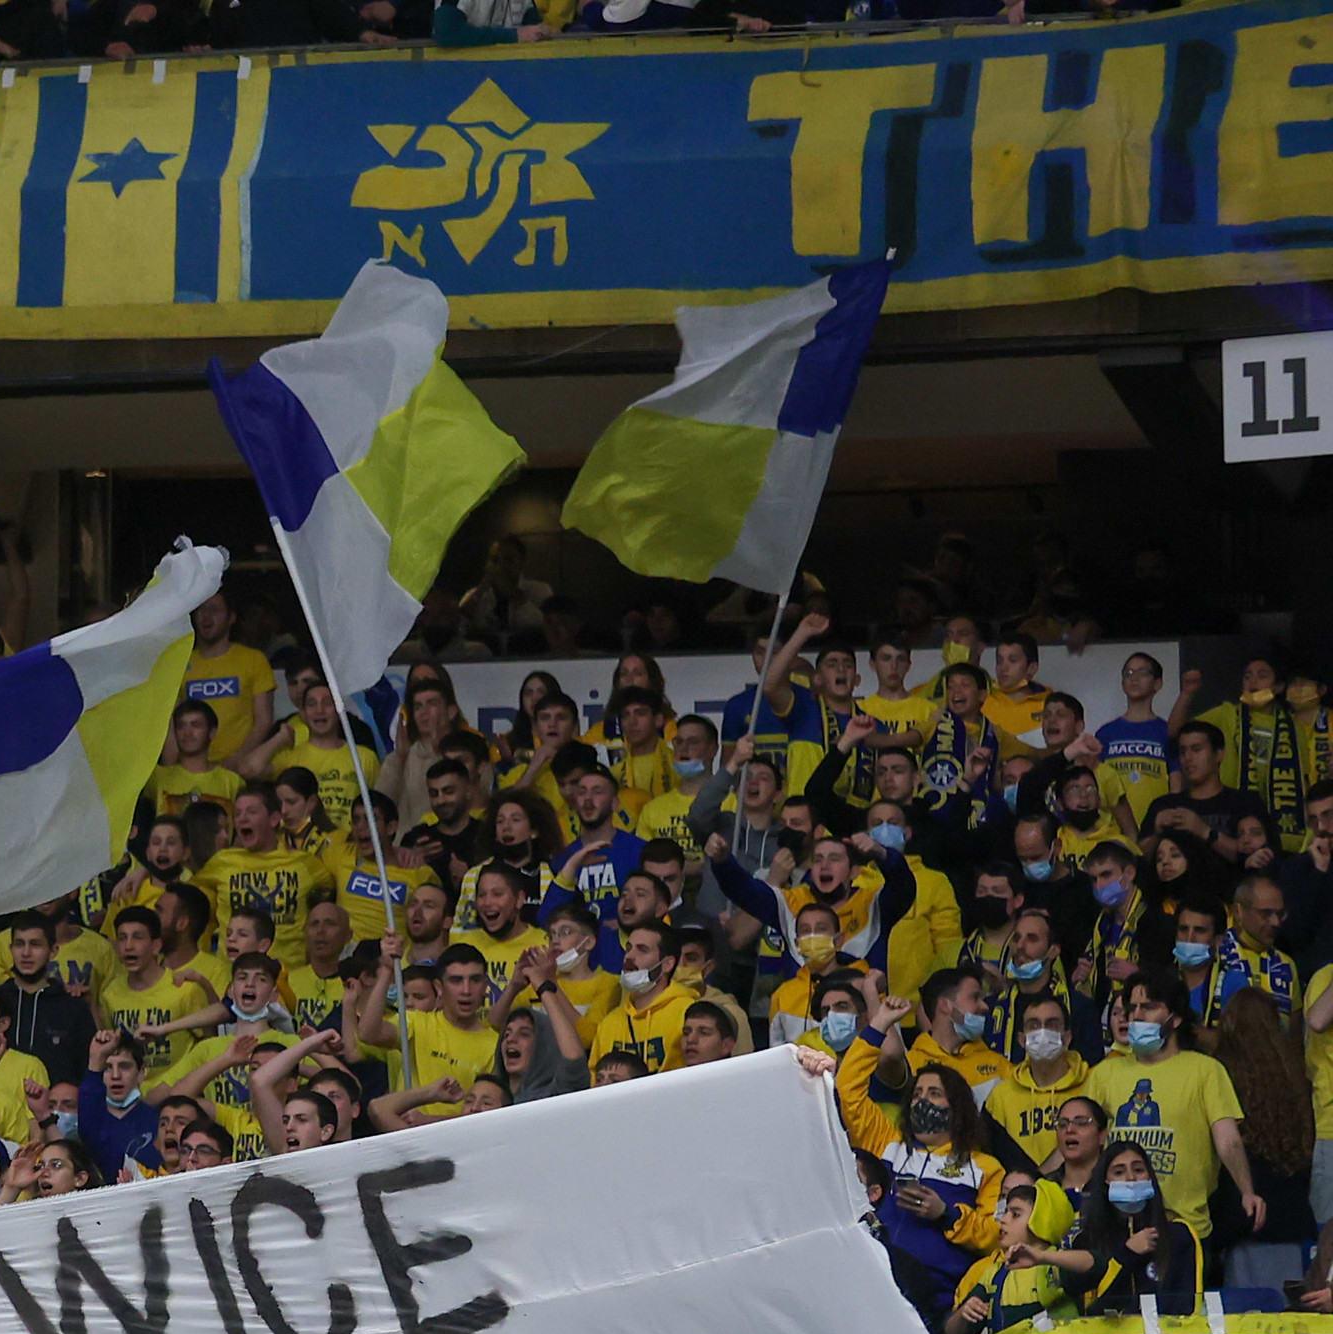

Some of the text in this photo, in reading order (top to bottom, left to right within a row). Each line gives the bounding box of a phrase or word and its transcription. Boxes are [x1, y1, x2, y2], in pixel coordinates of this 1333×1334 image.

[747, 15, 1333, 256] THE
[1240, 356, 1321, 438] 11
[188, 679, 235, 697] FOX
[229, 871, 299, 890] NOW I'M
[351, 876, 403, 901] FOX
[147, 1008, 172, 1024] I'M
[1018, 1106, 1059, 1137] 193
